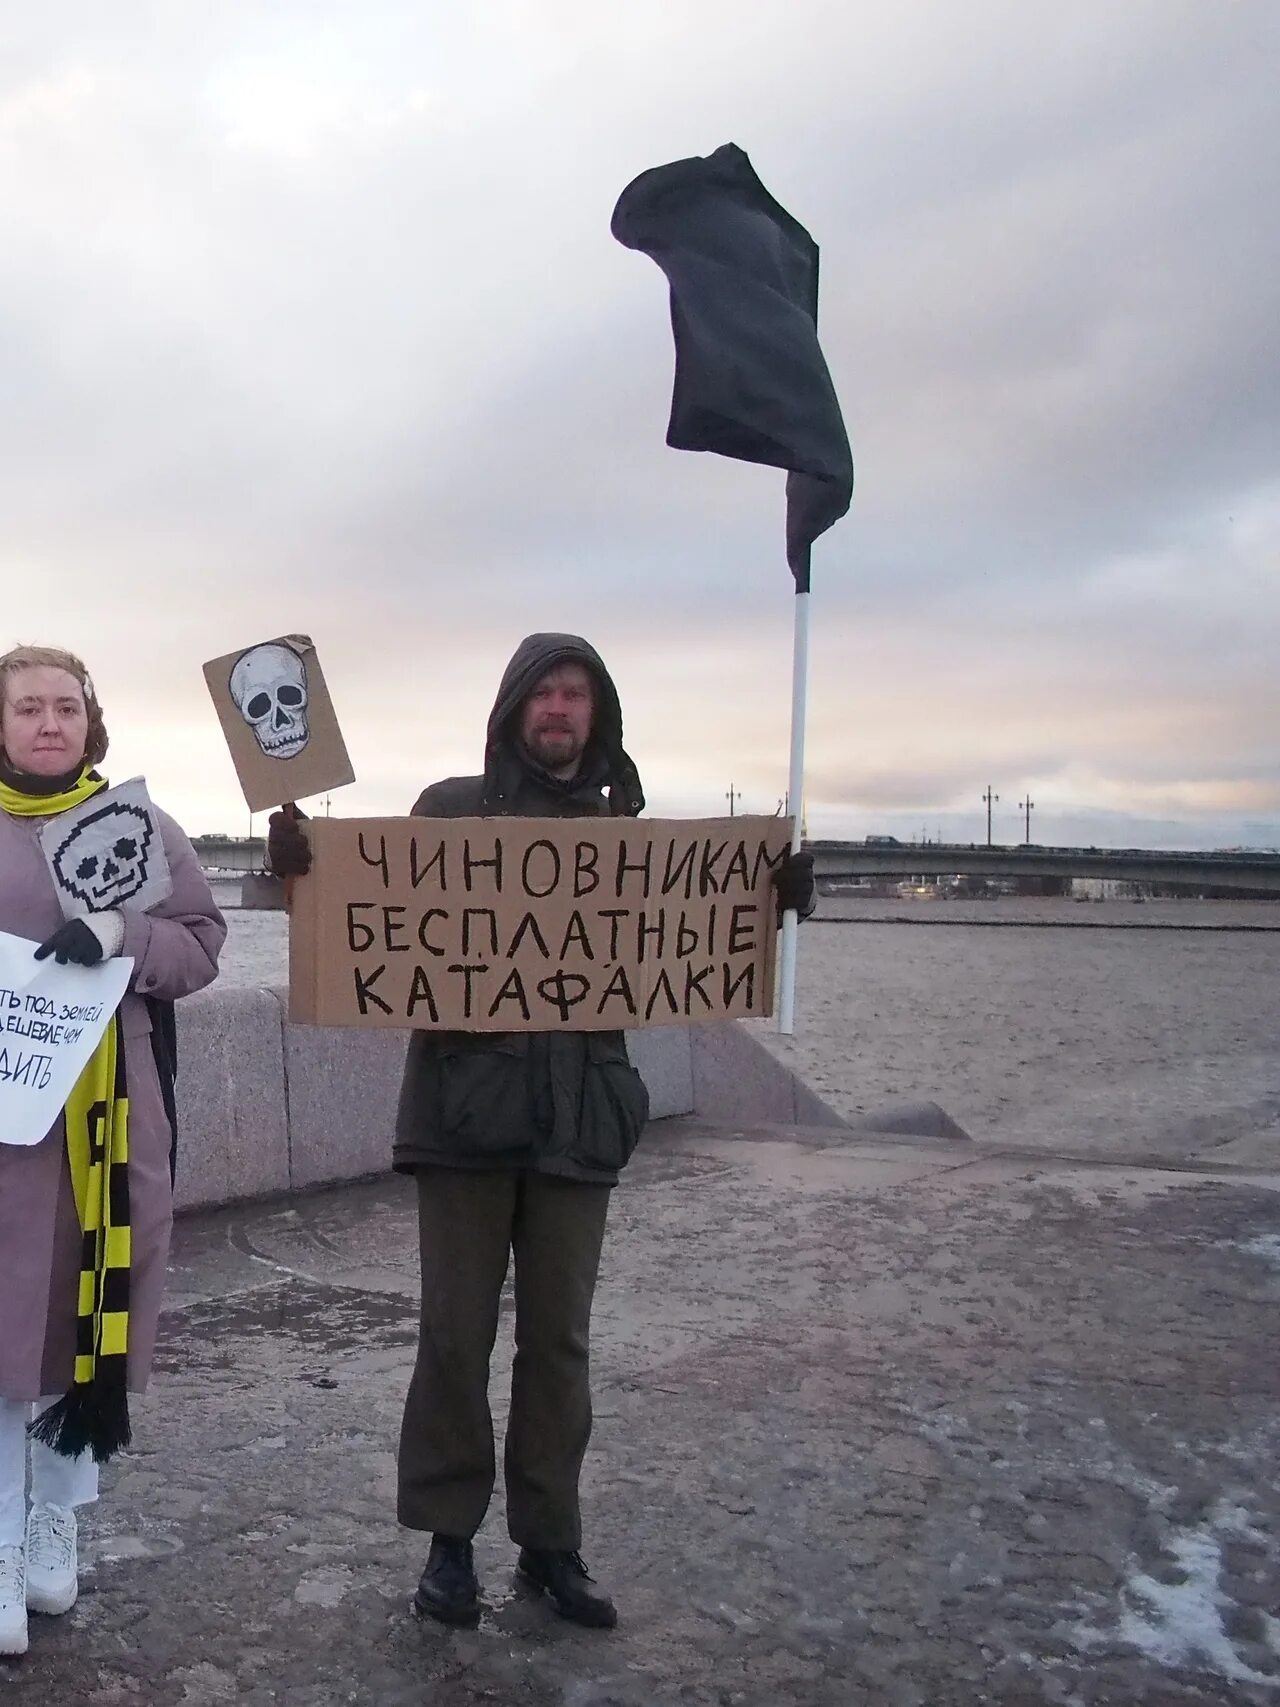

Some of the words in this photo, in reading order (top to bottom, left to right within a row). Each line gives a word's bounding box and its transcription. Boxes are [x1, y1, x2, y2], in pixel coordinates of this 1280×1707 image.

[358, 833, 791, 899] ЧИНОВНИКАМ
[346, 903, 757, 963] БЕСПЛАТНЫЕ
[25, 995, 56, 1018] под
[354, 962, 755, 1022] КАТАФАЛКИ
